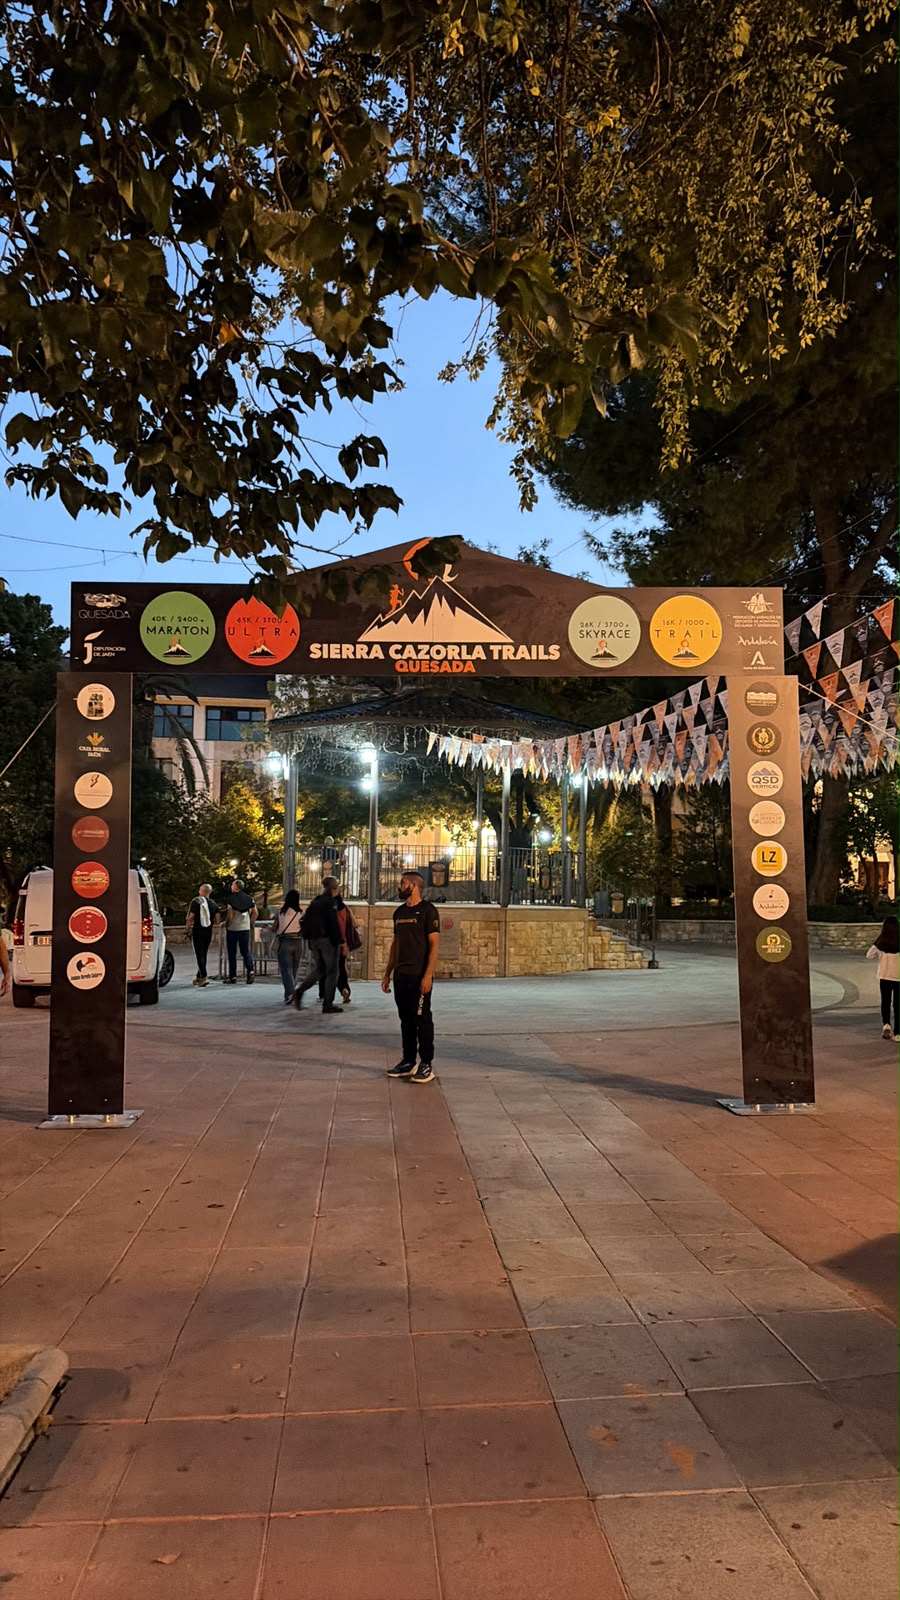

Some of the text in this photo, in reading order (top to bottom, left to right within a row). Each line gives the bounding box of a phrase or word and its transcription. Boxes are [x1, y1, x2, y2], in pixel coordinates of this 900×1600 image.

[79, 609, 131, 619] QUESADA
[151, 615, 167, 623] 40K
[146, 625, 209, 635] MARATON
[227, 627, 297, 636] ULTRA
[578, 629, 631, 639] SKYRACE
[654, 629, 718, 638] TRAIL
[309, 643, 561, 661] SIERRA CAZORLA TRAILS
[395, 660, 476, 673] QUESADA
[751, 776, 779, 784] QSD
[761, 850, 777, 863] LZ
